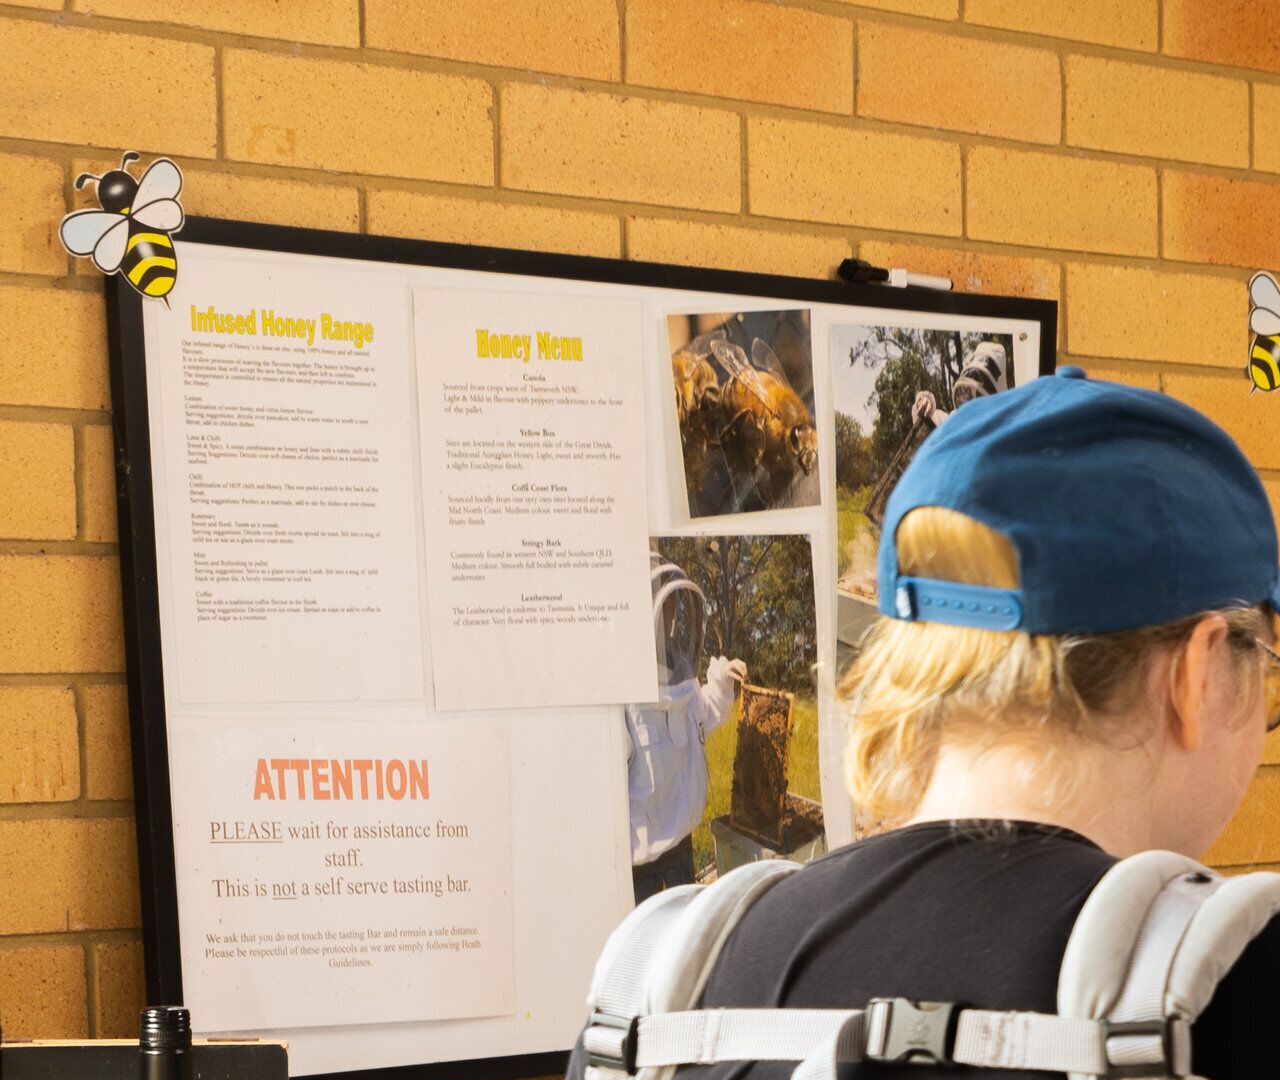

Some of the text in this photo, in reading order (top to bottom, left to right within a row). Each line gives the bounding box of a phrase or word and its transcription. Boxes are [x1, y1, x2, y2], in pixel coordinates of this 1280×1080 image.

[191, 305, 374, 348] Infused Honey Range
[476, 329, 583, 363] Honey Menu
[254, 759, 429, 800] ATTENTION
[210, 821, 468, 842] PLEASE wait for assistance from
[325, 849, 363, 867] staff.
[212, 876, 471, 898] This is not a self serve tasting bar.
[206, 934, 221, 943] We
[223, 934, 239, 943] ask
[240, 933, 256, 942] that
[275, 933, 285, 941] do
[301, 931, 323, 940] touch
[325, 931, 338, 940] the
[338, 932, 365, 941] tasting
[367, 930, 381, 938] Bar
[383, 929, 398, 938] and
[434, 928, 449, 936] safe
[205, 949, 234, 958] Please
[236, 948, 247, 956] be
[249, 947, 288, 957] respectful
[290, 946, 299, 955] of
[300, 946, 320, 954] these
[322, 946, 358, 954] protocols
[398, 942, 423, 952] simply
[426, 941, 460, 950] following
